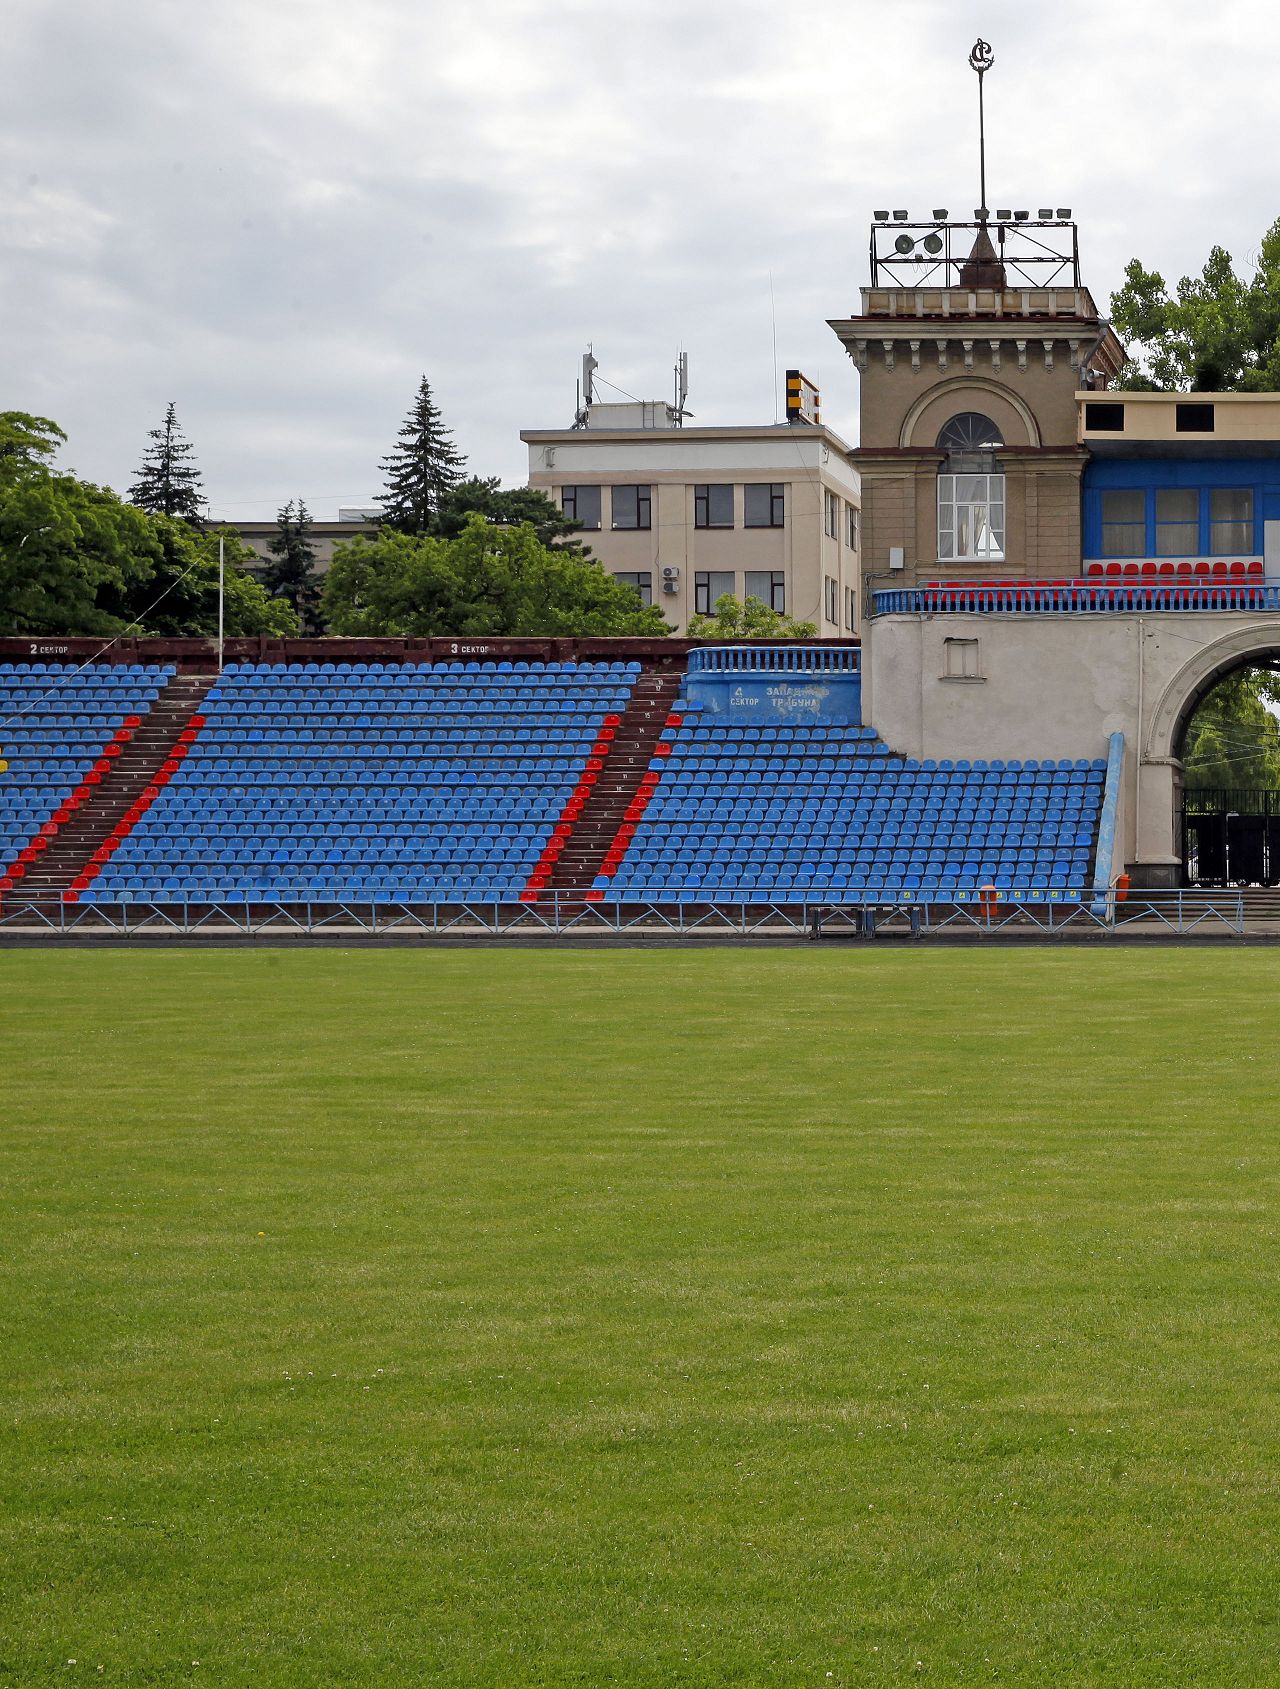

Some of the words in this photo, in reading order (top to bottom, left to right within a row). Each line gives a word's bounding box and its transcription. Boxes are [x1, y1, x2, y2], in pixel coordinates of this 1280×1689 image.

[30, 644, 38, 654] 2
[40, 646, 69, 654] СЕКТОР
[451, 643, 458, 654] 3
[730, 698, 759, 706] СЕКТОР
